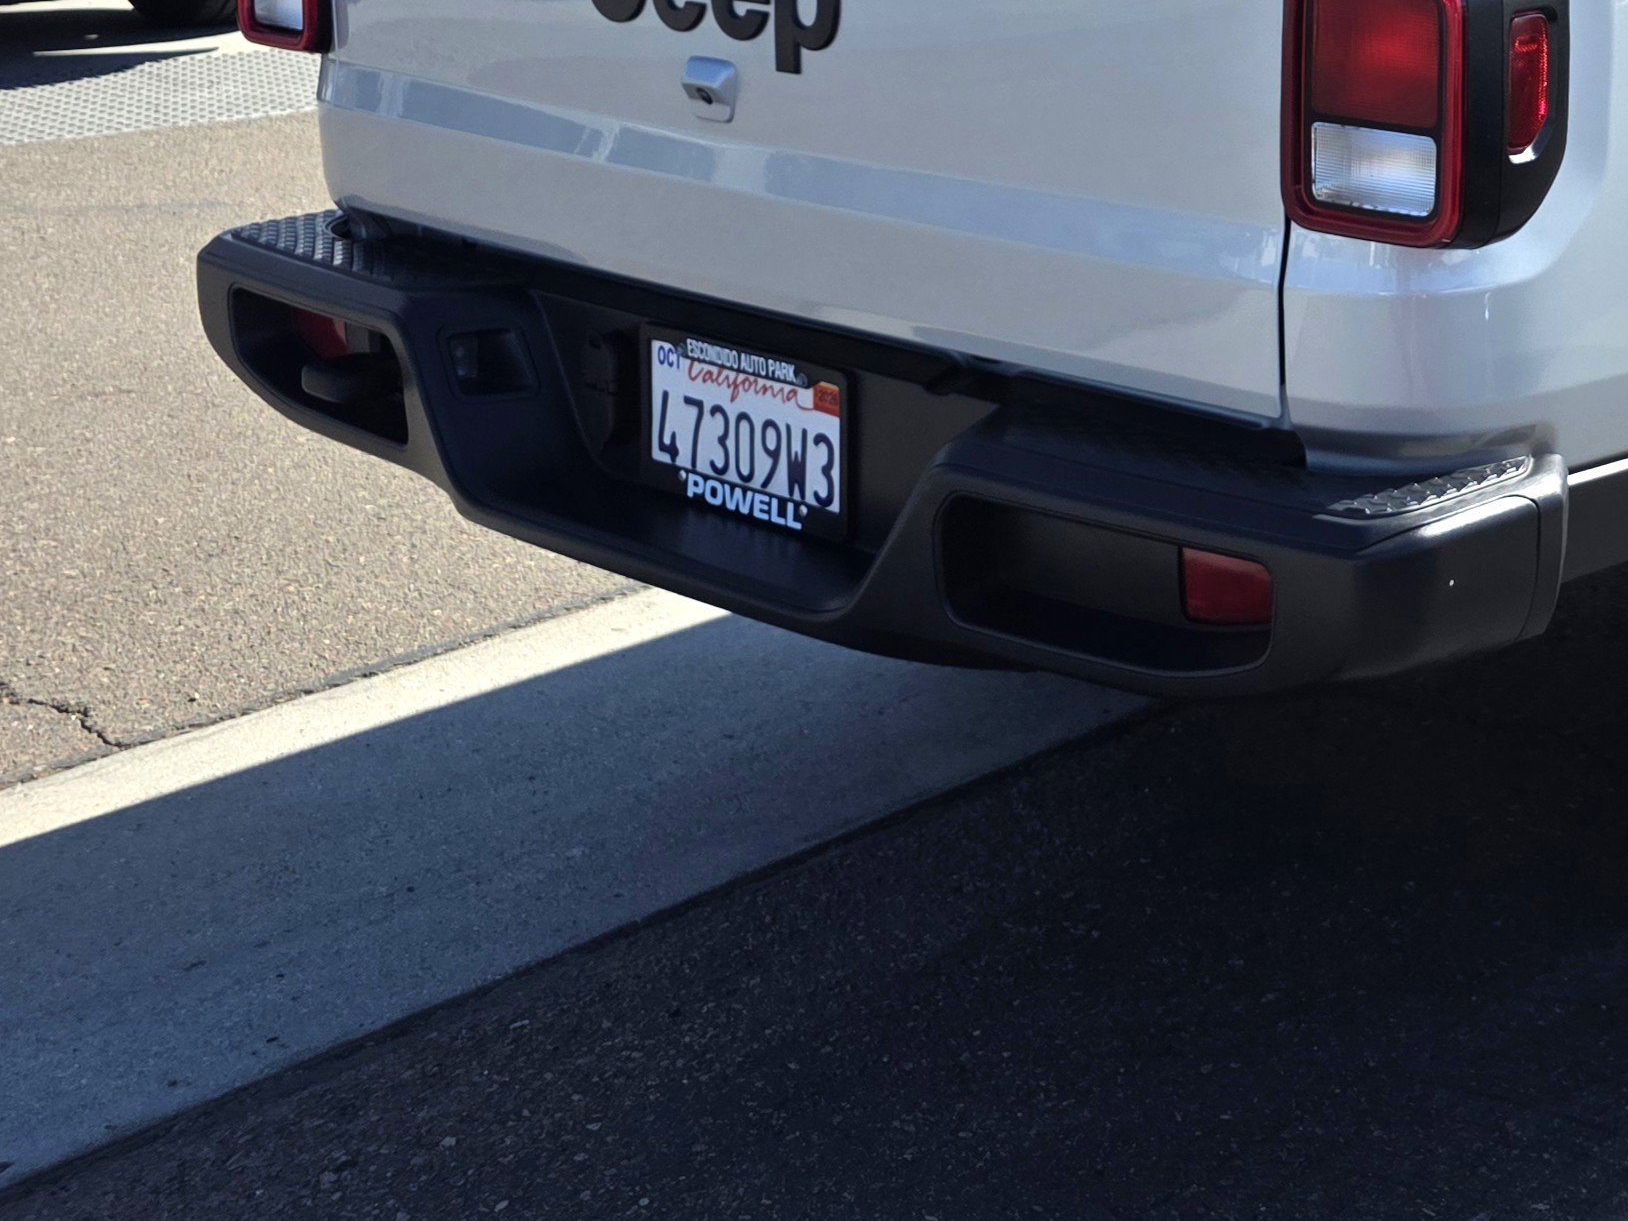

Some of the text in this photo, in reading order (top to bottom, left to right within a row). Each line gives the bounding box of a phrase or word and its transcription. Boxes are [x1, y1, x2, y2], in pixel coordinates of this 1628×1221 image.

[686, 338, 797, 383] ESCONDIDO AUTO PARK
[688, 360, 814, 410] California
[658, 389, 836, 509] 47309W3
[686, 472, 803, 531] POWELL
